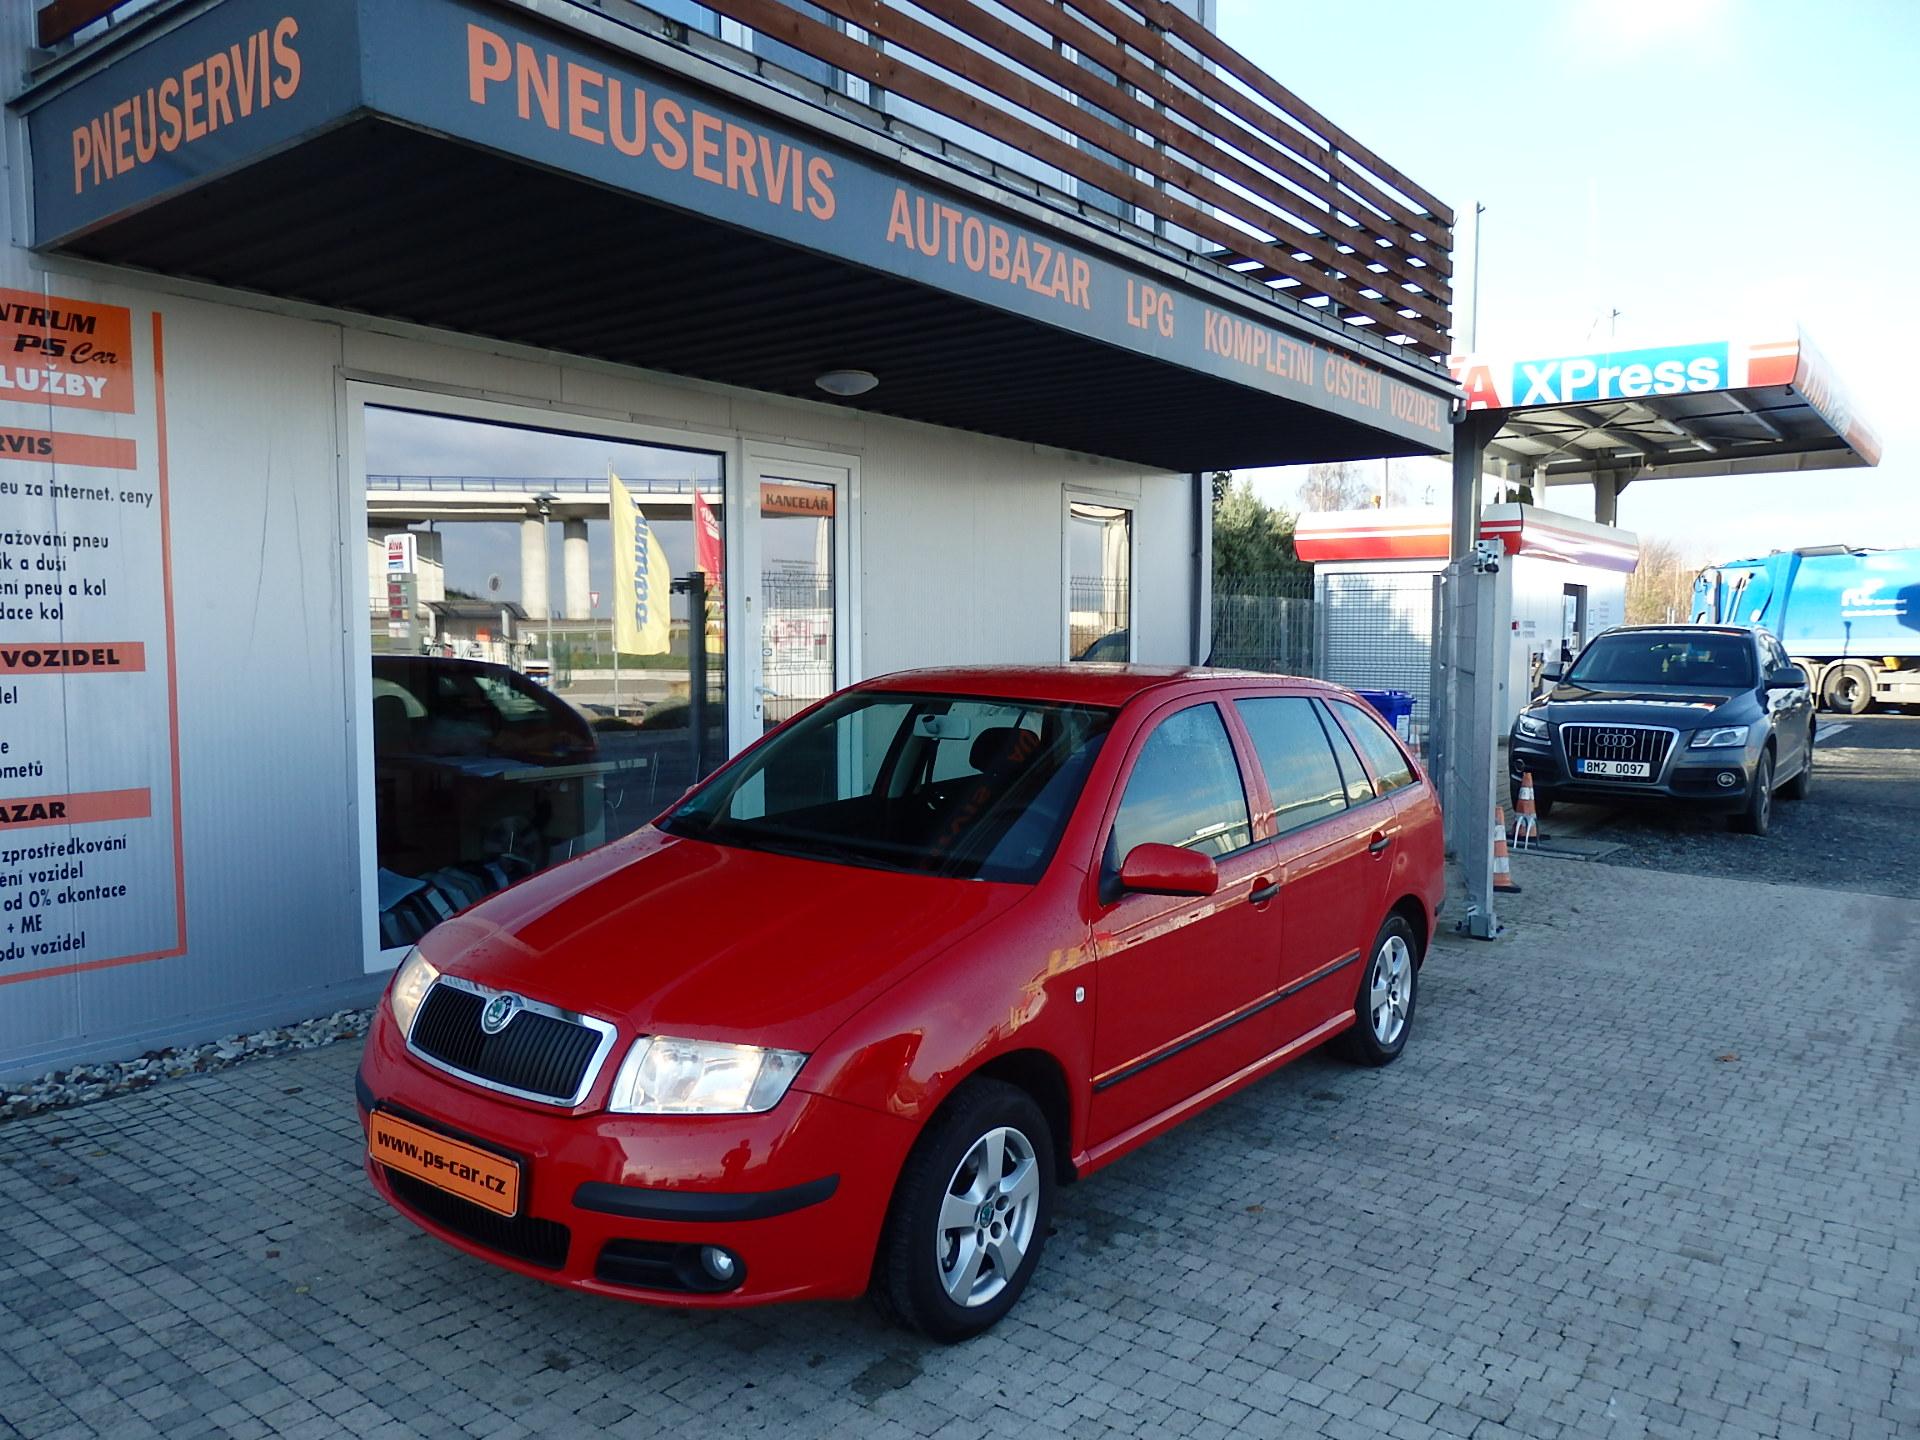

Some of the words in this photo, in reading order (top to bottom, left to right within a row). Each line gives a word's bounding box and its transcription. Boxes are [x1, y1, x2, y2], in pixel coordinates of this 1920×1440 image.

[73, 16, 301, 195] PNEUSERVIS
[467, 23, 836, 221] PNEUSERVIS
[886, 188, 1090, 310] AUTOBAZAR
[1126, 279, 1174, 338] LPG
[1204, 309, 1317, 386] KOMPLETNÍ
[1324, 347, 1383, 410] ČIŠTĚNÍ
[1390, 382, 1441, 432] VOZIDEL
[13, 333, 67, 357] PS
[71, 342, 119, 364] Car
[1520, 356, 1720, 407] XPress
[25, 484, 43, 496] za
[50, 480, 115, 502] internet.
[120, 490, 153, 509] ceny
[766, 493, 829, 511] KANCELÁŘ
[73, 536, 109, 552] pneu
[20, 559, 29, 570] a
[0, 578, 18, 595] ní
[25, 583, 62, 599] pneu
[68, 584, 77, 596] a
[84, 578, 107, 596] kol
[40, 602, 63, 620] kol
[1, 648, 120, 668] VOZIDEL
[1586, 761, 1607, 773] 8M2
[1615, 763, 1644, 775] 0097
[2, 833, 127, 866] zprostředkování
[29, 860, 84, 883] vozidel
[4, 892, 22, 911] od
[29, 888, 52, 908] 0%
[57, 885, 127, 904] akontace
[21, 914, 42, 934] ME
[31, 931, 86, 956] vozidel
[377, 1131, 506, 1195] www.ps-car.cz
